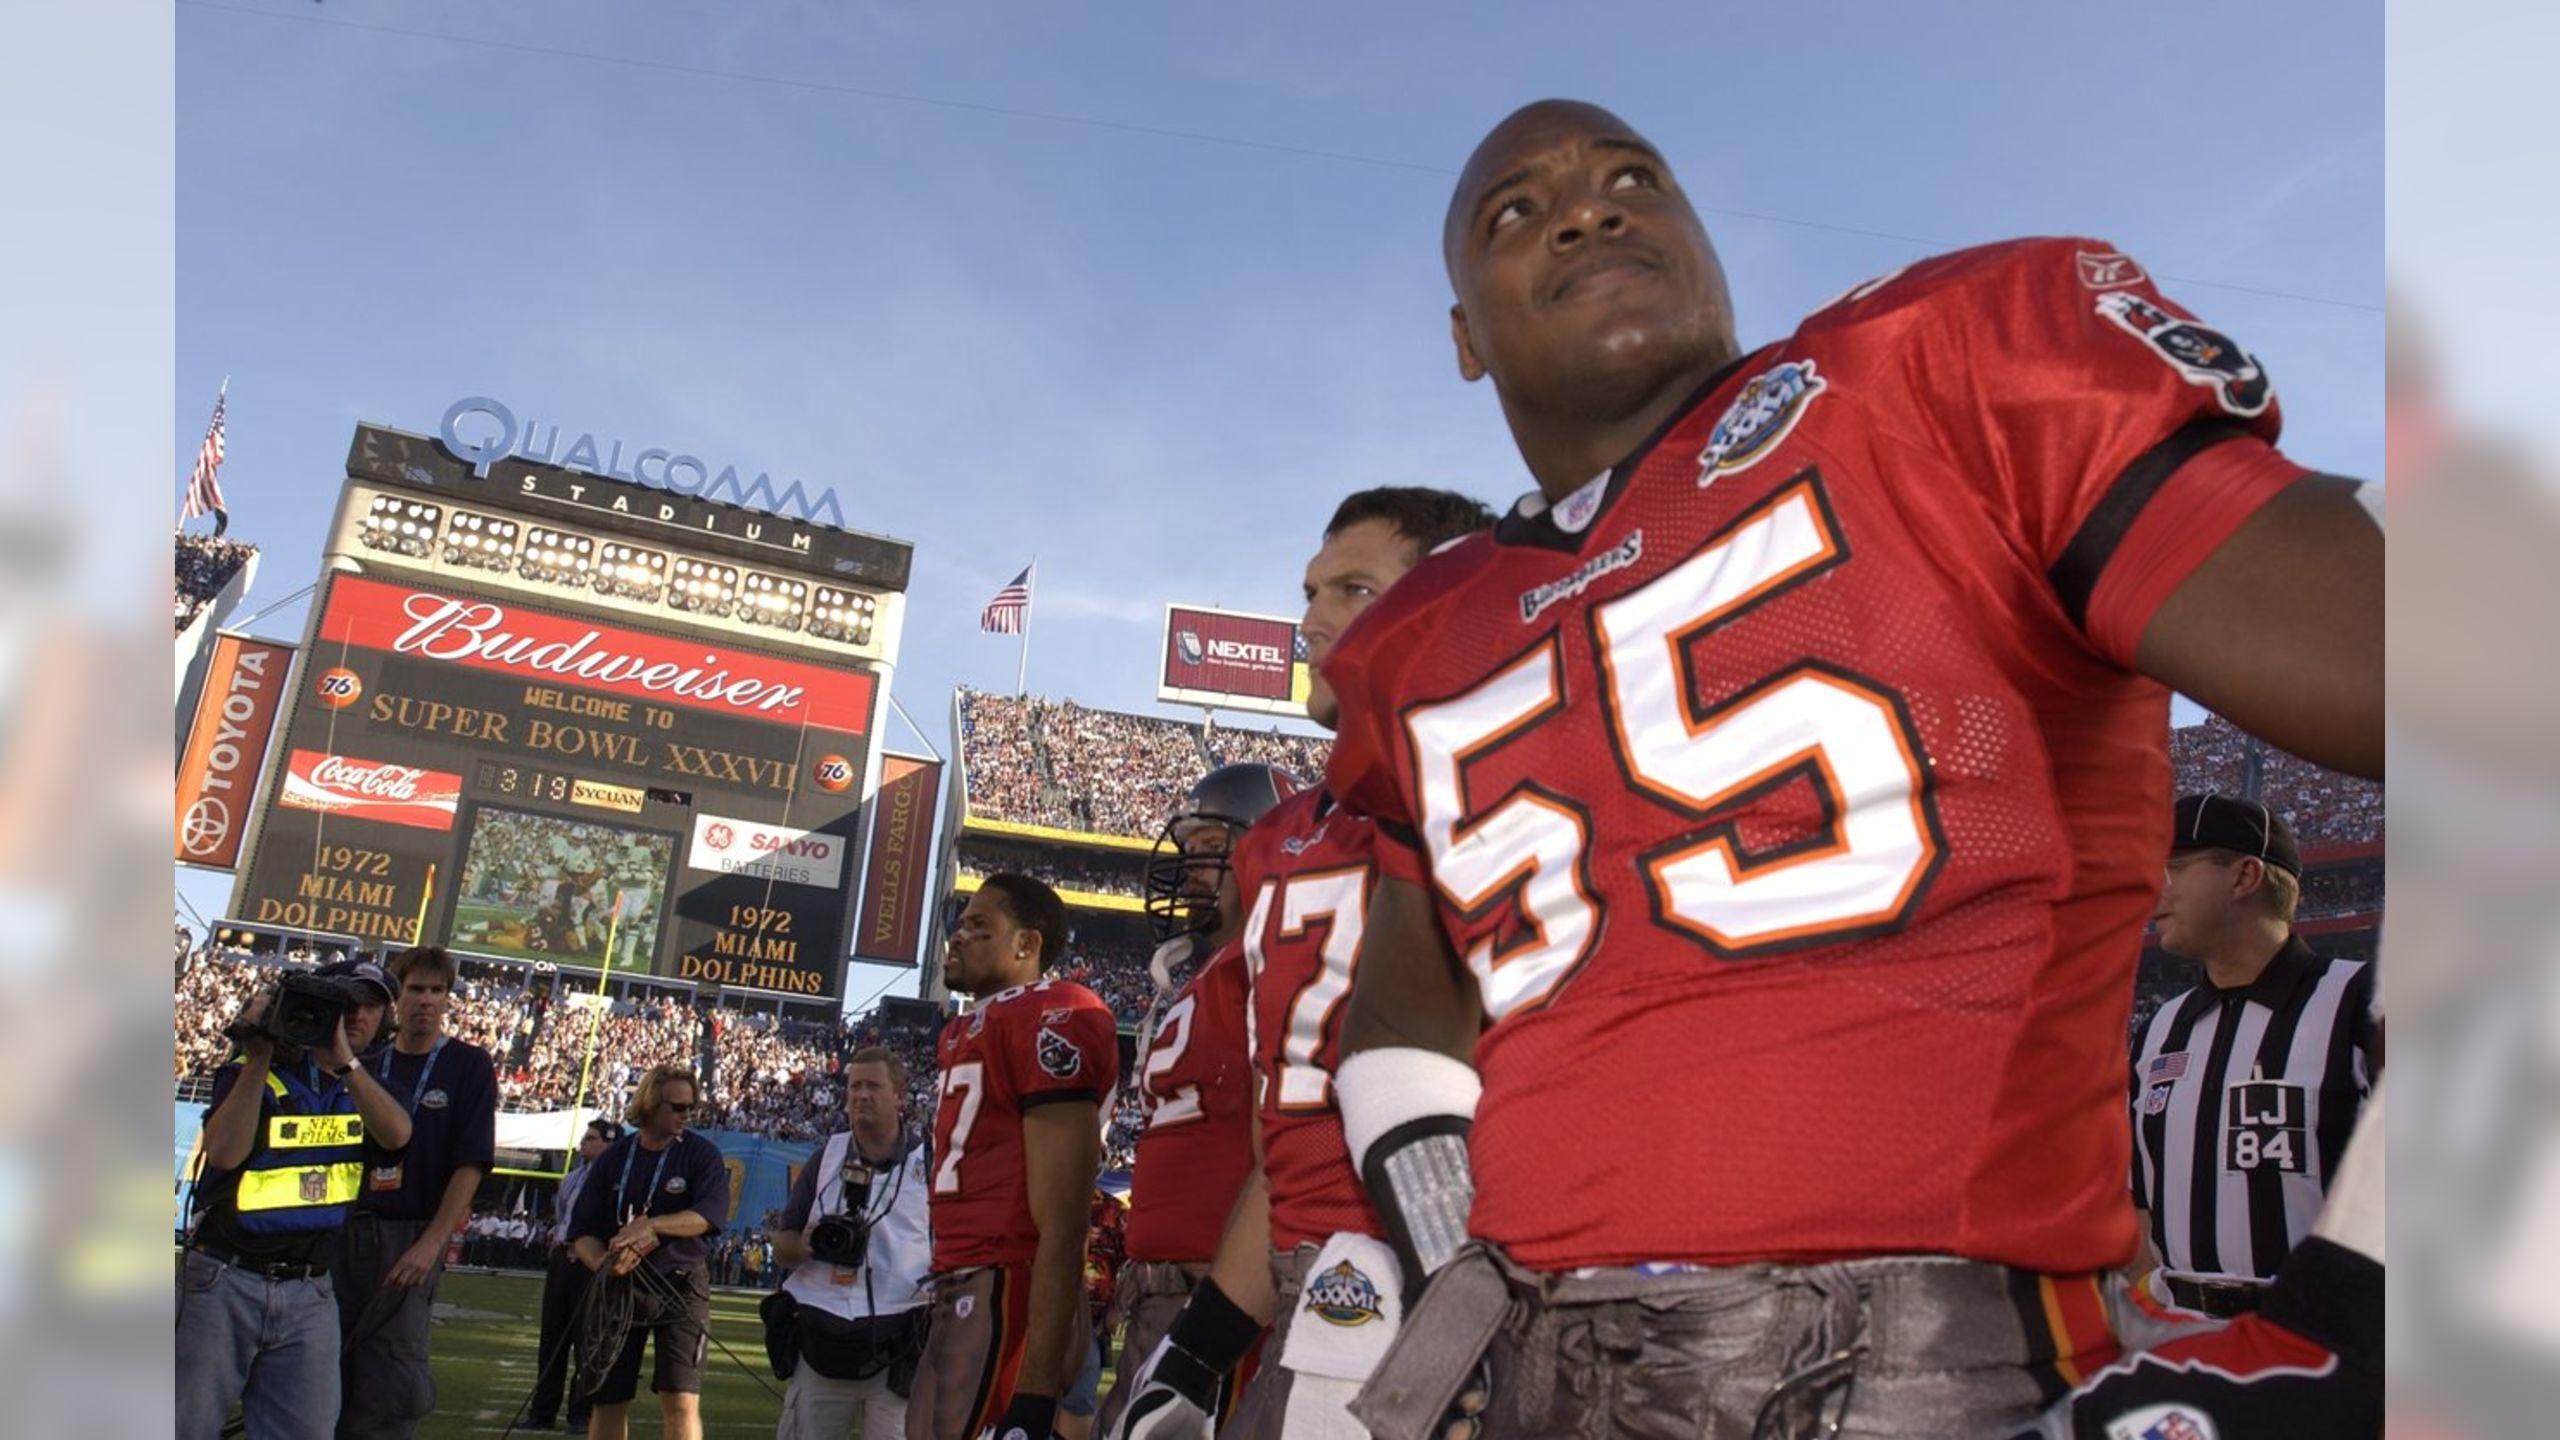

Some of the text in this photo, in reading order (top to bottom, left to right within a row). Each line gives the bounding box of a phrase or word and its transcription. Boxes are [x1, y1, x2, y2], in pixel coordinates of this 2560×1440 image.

[441, 396, 845, 528] QUALCOMM
[522, 475, 811, 550] STADIUM
[393, 592, 804, 710] Budweiser
[1207, 639, 1284, 664] NEXTEL
[324, 677, 352, 694] 76
[201, 650, 269, 792] TOYOTA
[524, 686, 674, 730] WELCOME TO
[370, 693, 798, 791] SUPER BOWL XXXVII
[1402, 470, 1944, 1019] 55
[820, 763, 845, 780] 76
[575, 785, 642, 807] SYCUAN
[319, 845, 392, 877] 1972
[750, 834, 830, 860] SANYO
[875, 775, 915, 943] WELLS FARGO
[721, 857, 811, 884] BATTERIES
[298, 873, 396, 908] MIAMI
[257, 898, 421, 941] DOLPHINS
[729, 904, 793, 933] 1972
[713, 931, 798, 963] MIAMI
[680, 955, 823, 994] DOLPHINS
[309, 1117, 338, 1131] NFL
[2240, 1087, 2287, 1125] LJ
[299, 1130, 347, 1144] FILMS
[2235, 1130, 2294, 1170] 84
